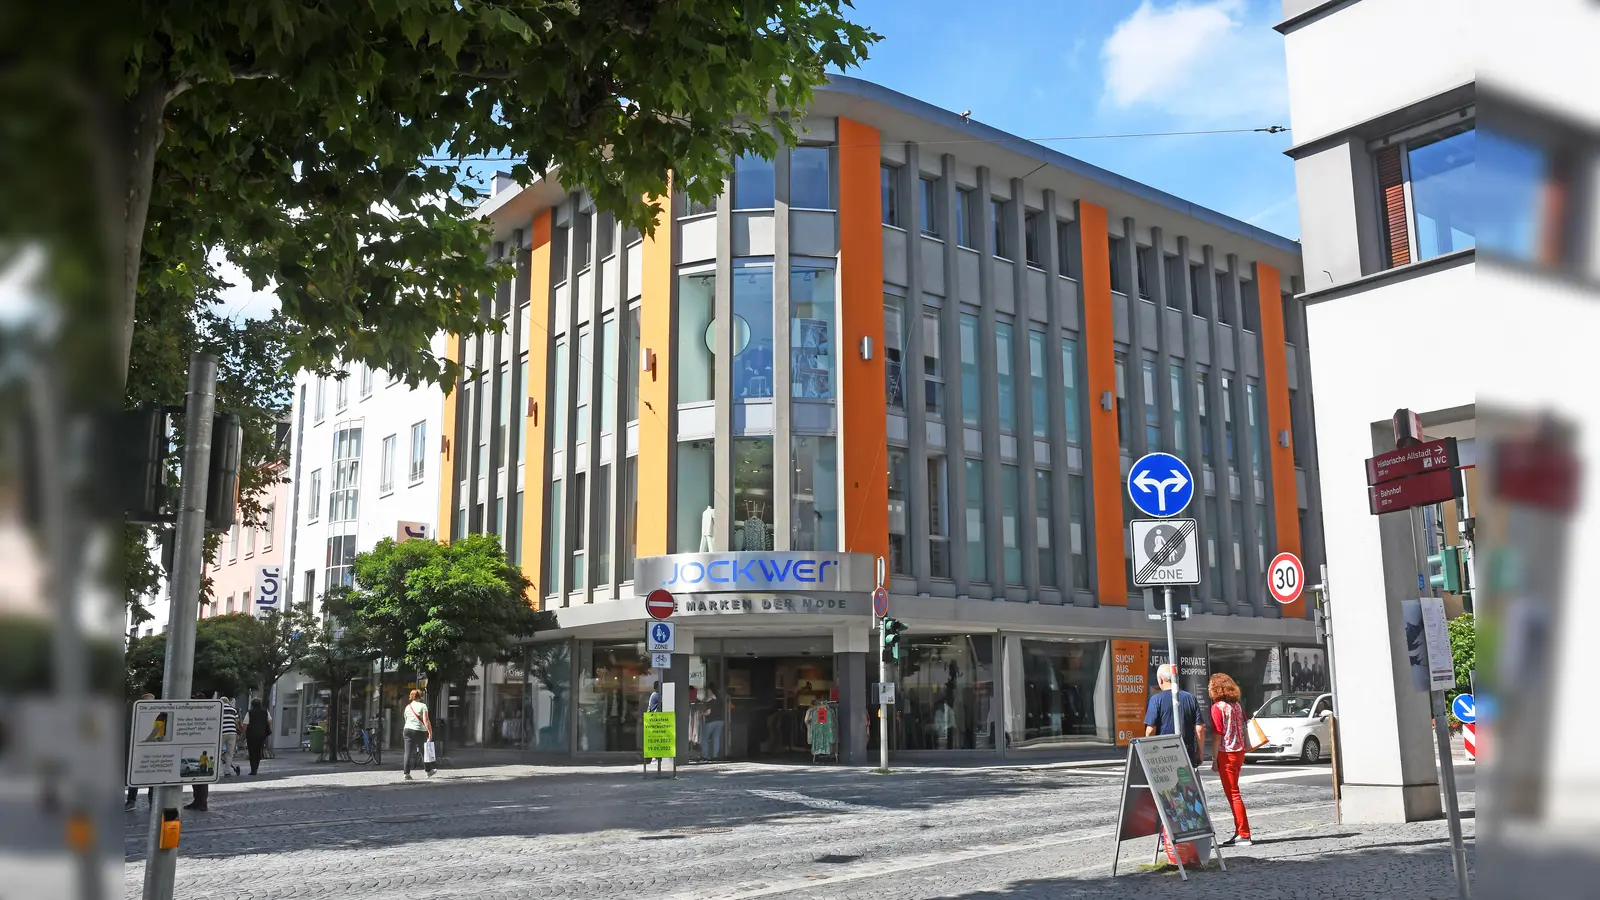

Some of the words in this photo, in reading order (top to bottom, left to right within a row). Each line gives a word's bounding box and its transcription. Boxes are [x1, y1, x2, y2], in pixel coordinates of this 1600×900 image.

[1377, 455, 1406, 468] Historische
[1406, 448, 1432, 461] Altstadt
[1434, 455, 1447, 465] WC
[1380, 485, 1402, 498] Bahnhof
[1151, 568, 1184, 580] ZONE
[1275, 566, 1296, 590] 30
[686, 598, 753, 612] MARKEN
[762, 598, 796, 611] DER
[802, 597, 847, 609] MODE
[1149, 655, 1170, 666] JEAN
[1180, 656, 1206, 666] PRIVATE
[1116, 664, 1129, 673] AUS
[1180, 667, 1207, 676] SHOPPING
[1116, 675, 1144, 684] PROBIER
